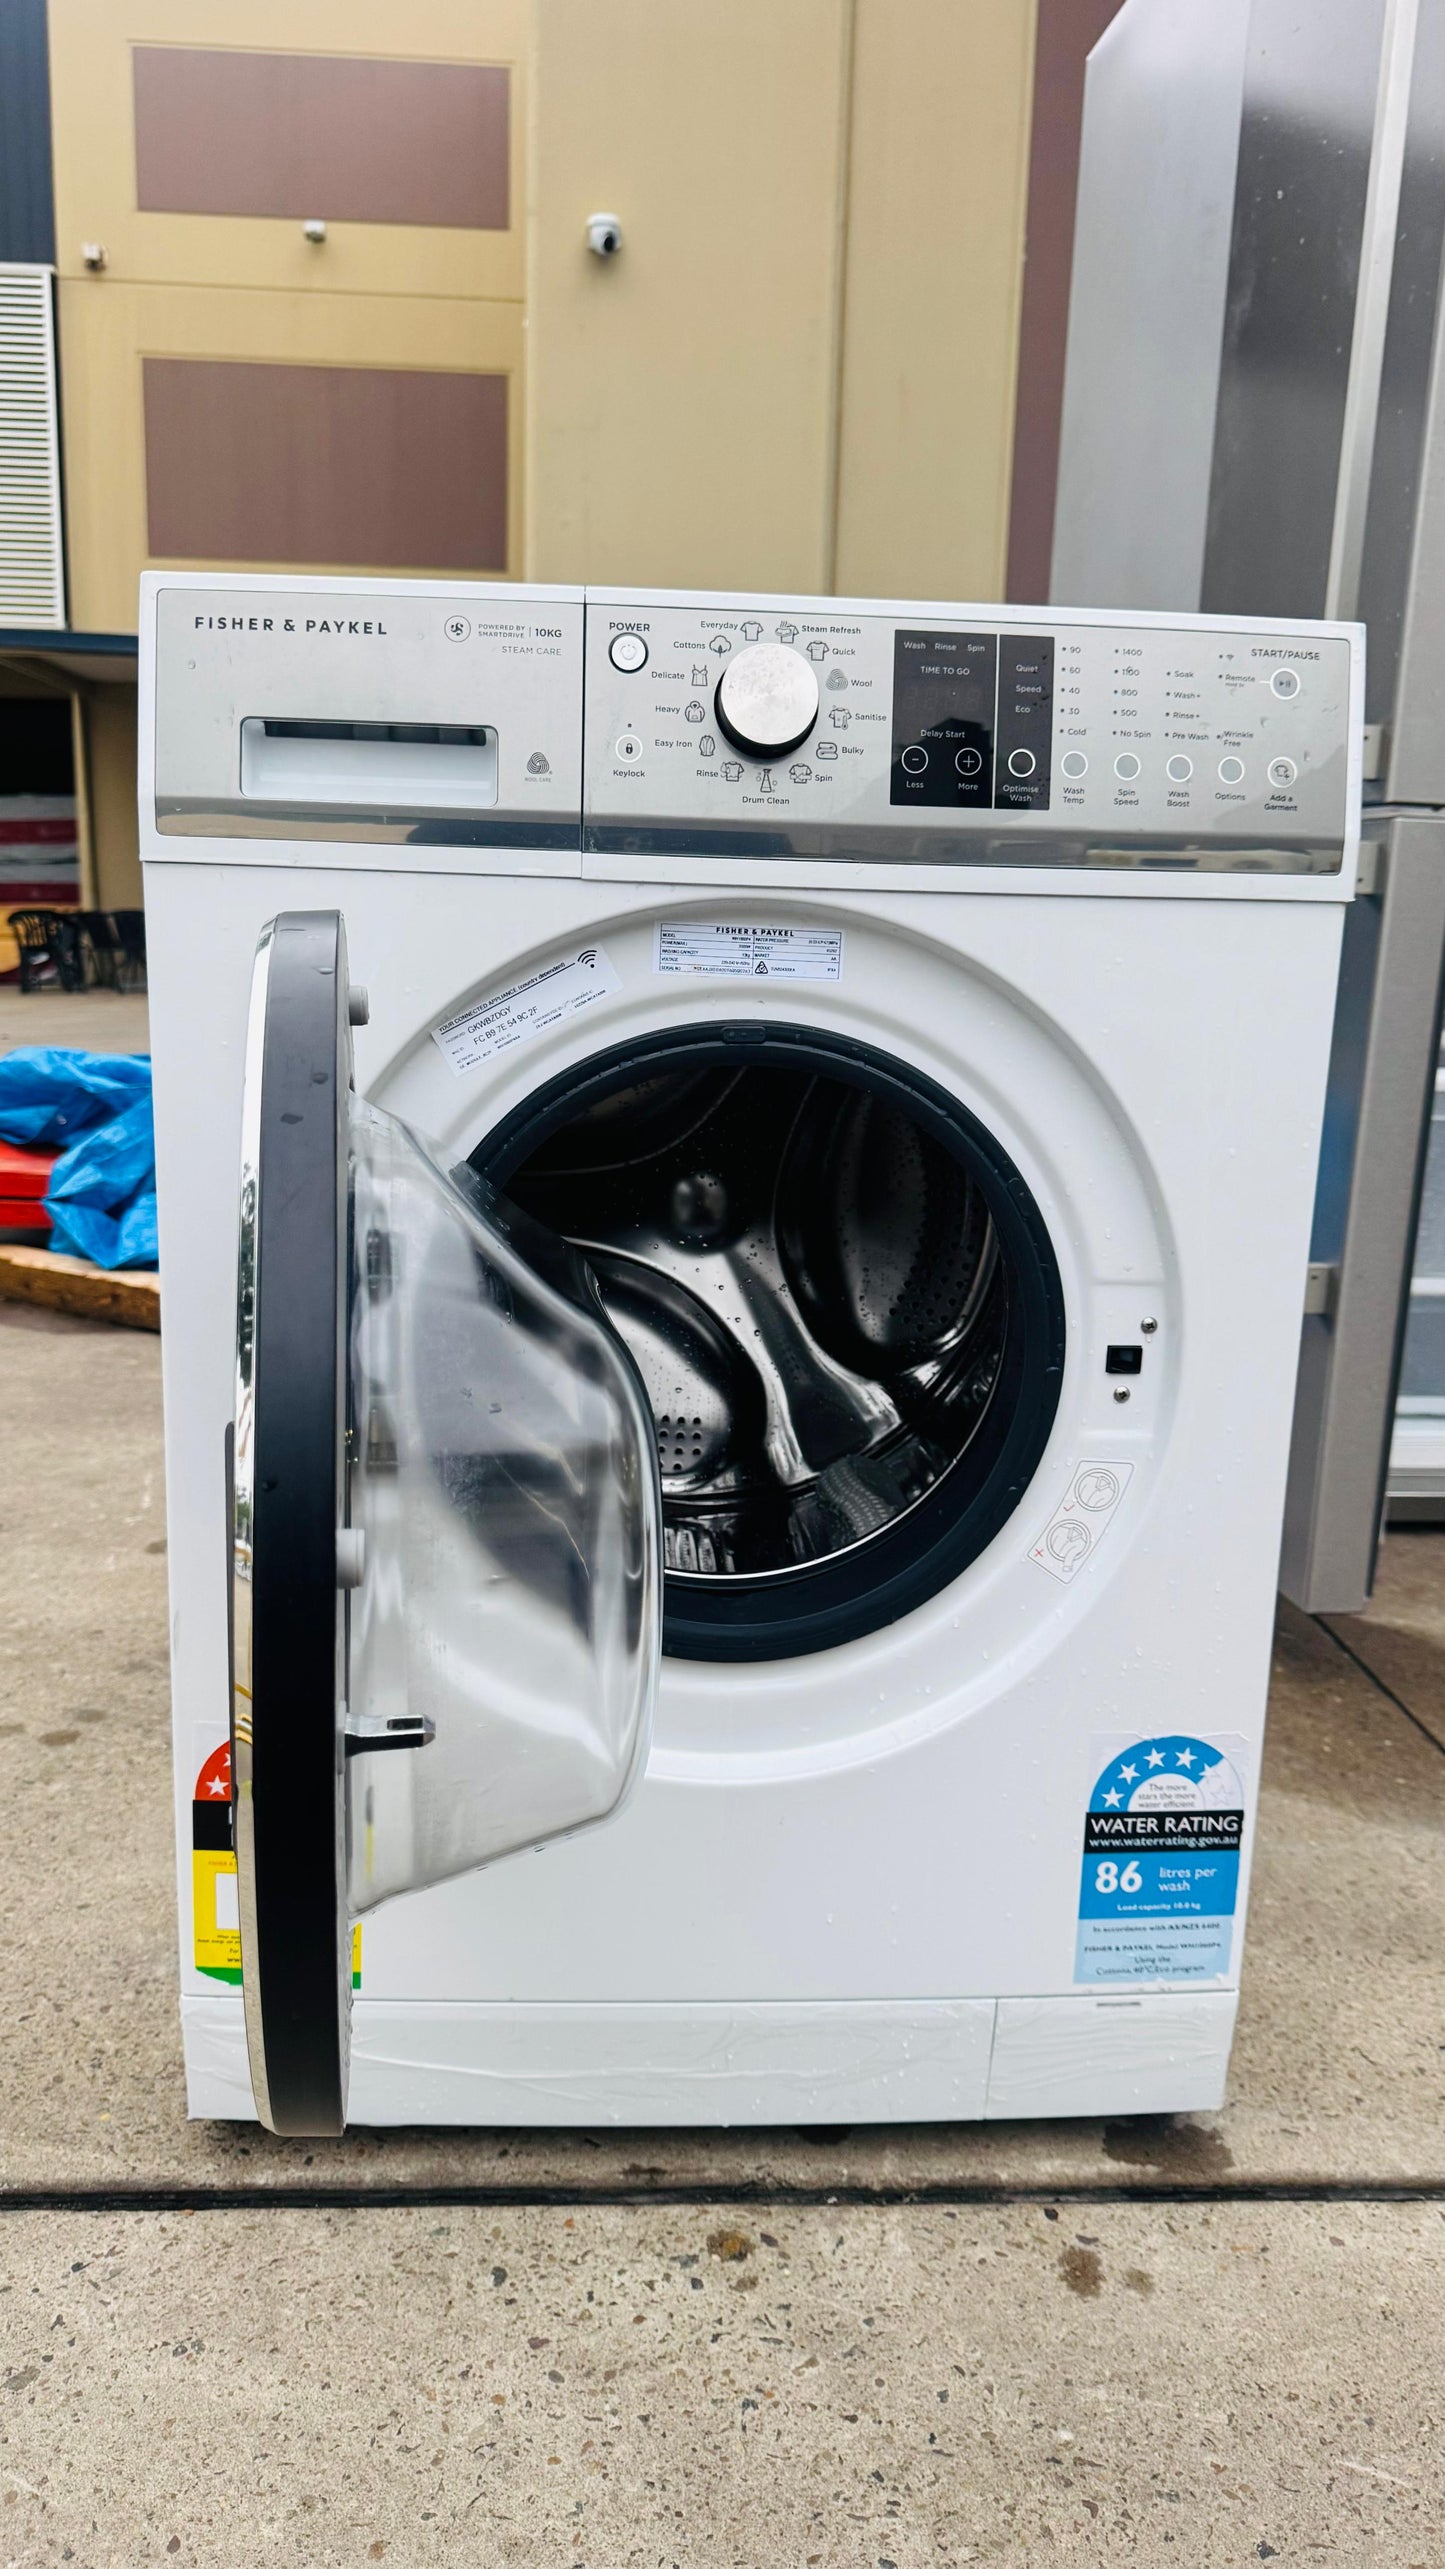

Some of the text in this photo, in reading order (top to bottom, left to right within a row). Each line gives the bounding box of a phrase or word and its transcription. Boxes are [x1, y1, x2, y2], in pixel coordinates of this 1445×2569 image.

[195, 616, 388, 635] FISHER & PAYKEL
[609, 622, 650, 631] POWER
[701, 621, 738, 631] Everyday
[802, 625, 861, 635] Steam Refresh
[536, 628, 562, 637] 10KG
[673, 641, 706, 649] Cottons
[904, 641, 926, 649] Wash
[934, 643, 957, 651] Rinse
[967, 644, 985, 653] Spin
[502, 646, 561, 656] STEAM CARE
[832, 647, 856, 656] Quick
[1251, 649, 1320, 660] START/PAUSE
[921, 666, 940, 675] TIME
[941, 667, 954, 675] TO
[1016, 664, 1038, 673] Quiet
[651, 671, 685, 680] Delicate
[1225, 674, 1255, 682] Remote
[851, 679, 872, 687] Wool
[1015, 685, 1042, 694] Speed
[655, 705, 681, 715] Heavy
[855, 713, 887, 721] Sanitise
[921, 729, 965, 739] Delay Start
[1067, 728, 1086, 736] Cold
[655, 739, 692, 749] Easy Iron
[842, 746, 864, 755] Bulky
[613, 769, 645, 779] Keylock
[696, 769, 718, 778] Rinse
[815, 774, 833, 783] Spin
[958, 783, 978, 791] More
[1003, 784, 1039, 795] Optimise
[1063, 787, 1085, 795] Wash
[1117, 789, 1136, 797] Spin
[1215, 792, 1246, 801] Options
[742, 797, 790, 805] Drum Clean
[1010, 794, 1032, 802] Wash
[1063, 796, 1084, 805] Temp
[1113, 798, 1139, 806] Speed
[1270, 794, 1286, 802] Add
[1264, 803, 1298, 812] Garment
[761, 929, 794, 937] PAYKEL
[439, 1021, 454, 1032] YOUR
[454, 1002, 488, 1025] CONNECTED
[488, 987, 517, 1006] APPLIANCE
[518, 977, 538, 991] (country
[473, 1035, 485, 1045] FC
[485, 1028, 496, 1040] B9
[497, 1023, 507, 1034] 7E
[507, 1017, 517, 1028] 54
[517, 1011, 528, 1022] 9C
[528, 1006, 539, 1017] 2F
[1163, 1800, 1195, 1808] efficient
[1091, 1816, 1239, 1834] WATER RATING
[1089, 1835, 1238, 1848] www.waterrating.gov.au
[1095, 1860, 1143, 1893] 86
[1159, 1866, 1217, 1880] litres per
[1158, 1880, 1191, 1892] wash
